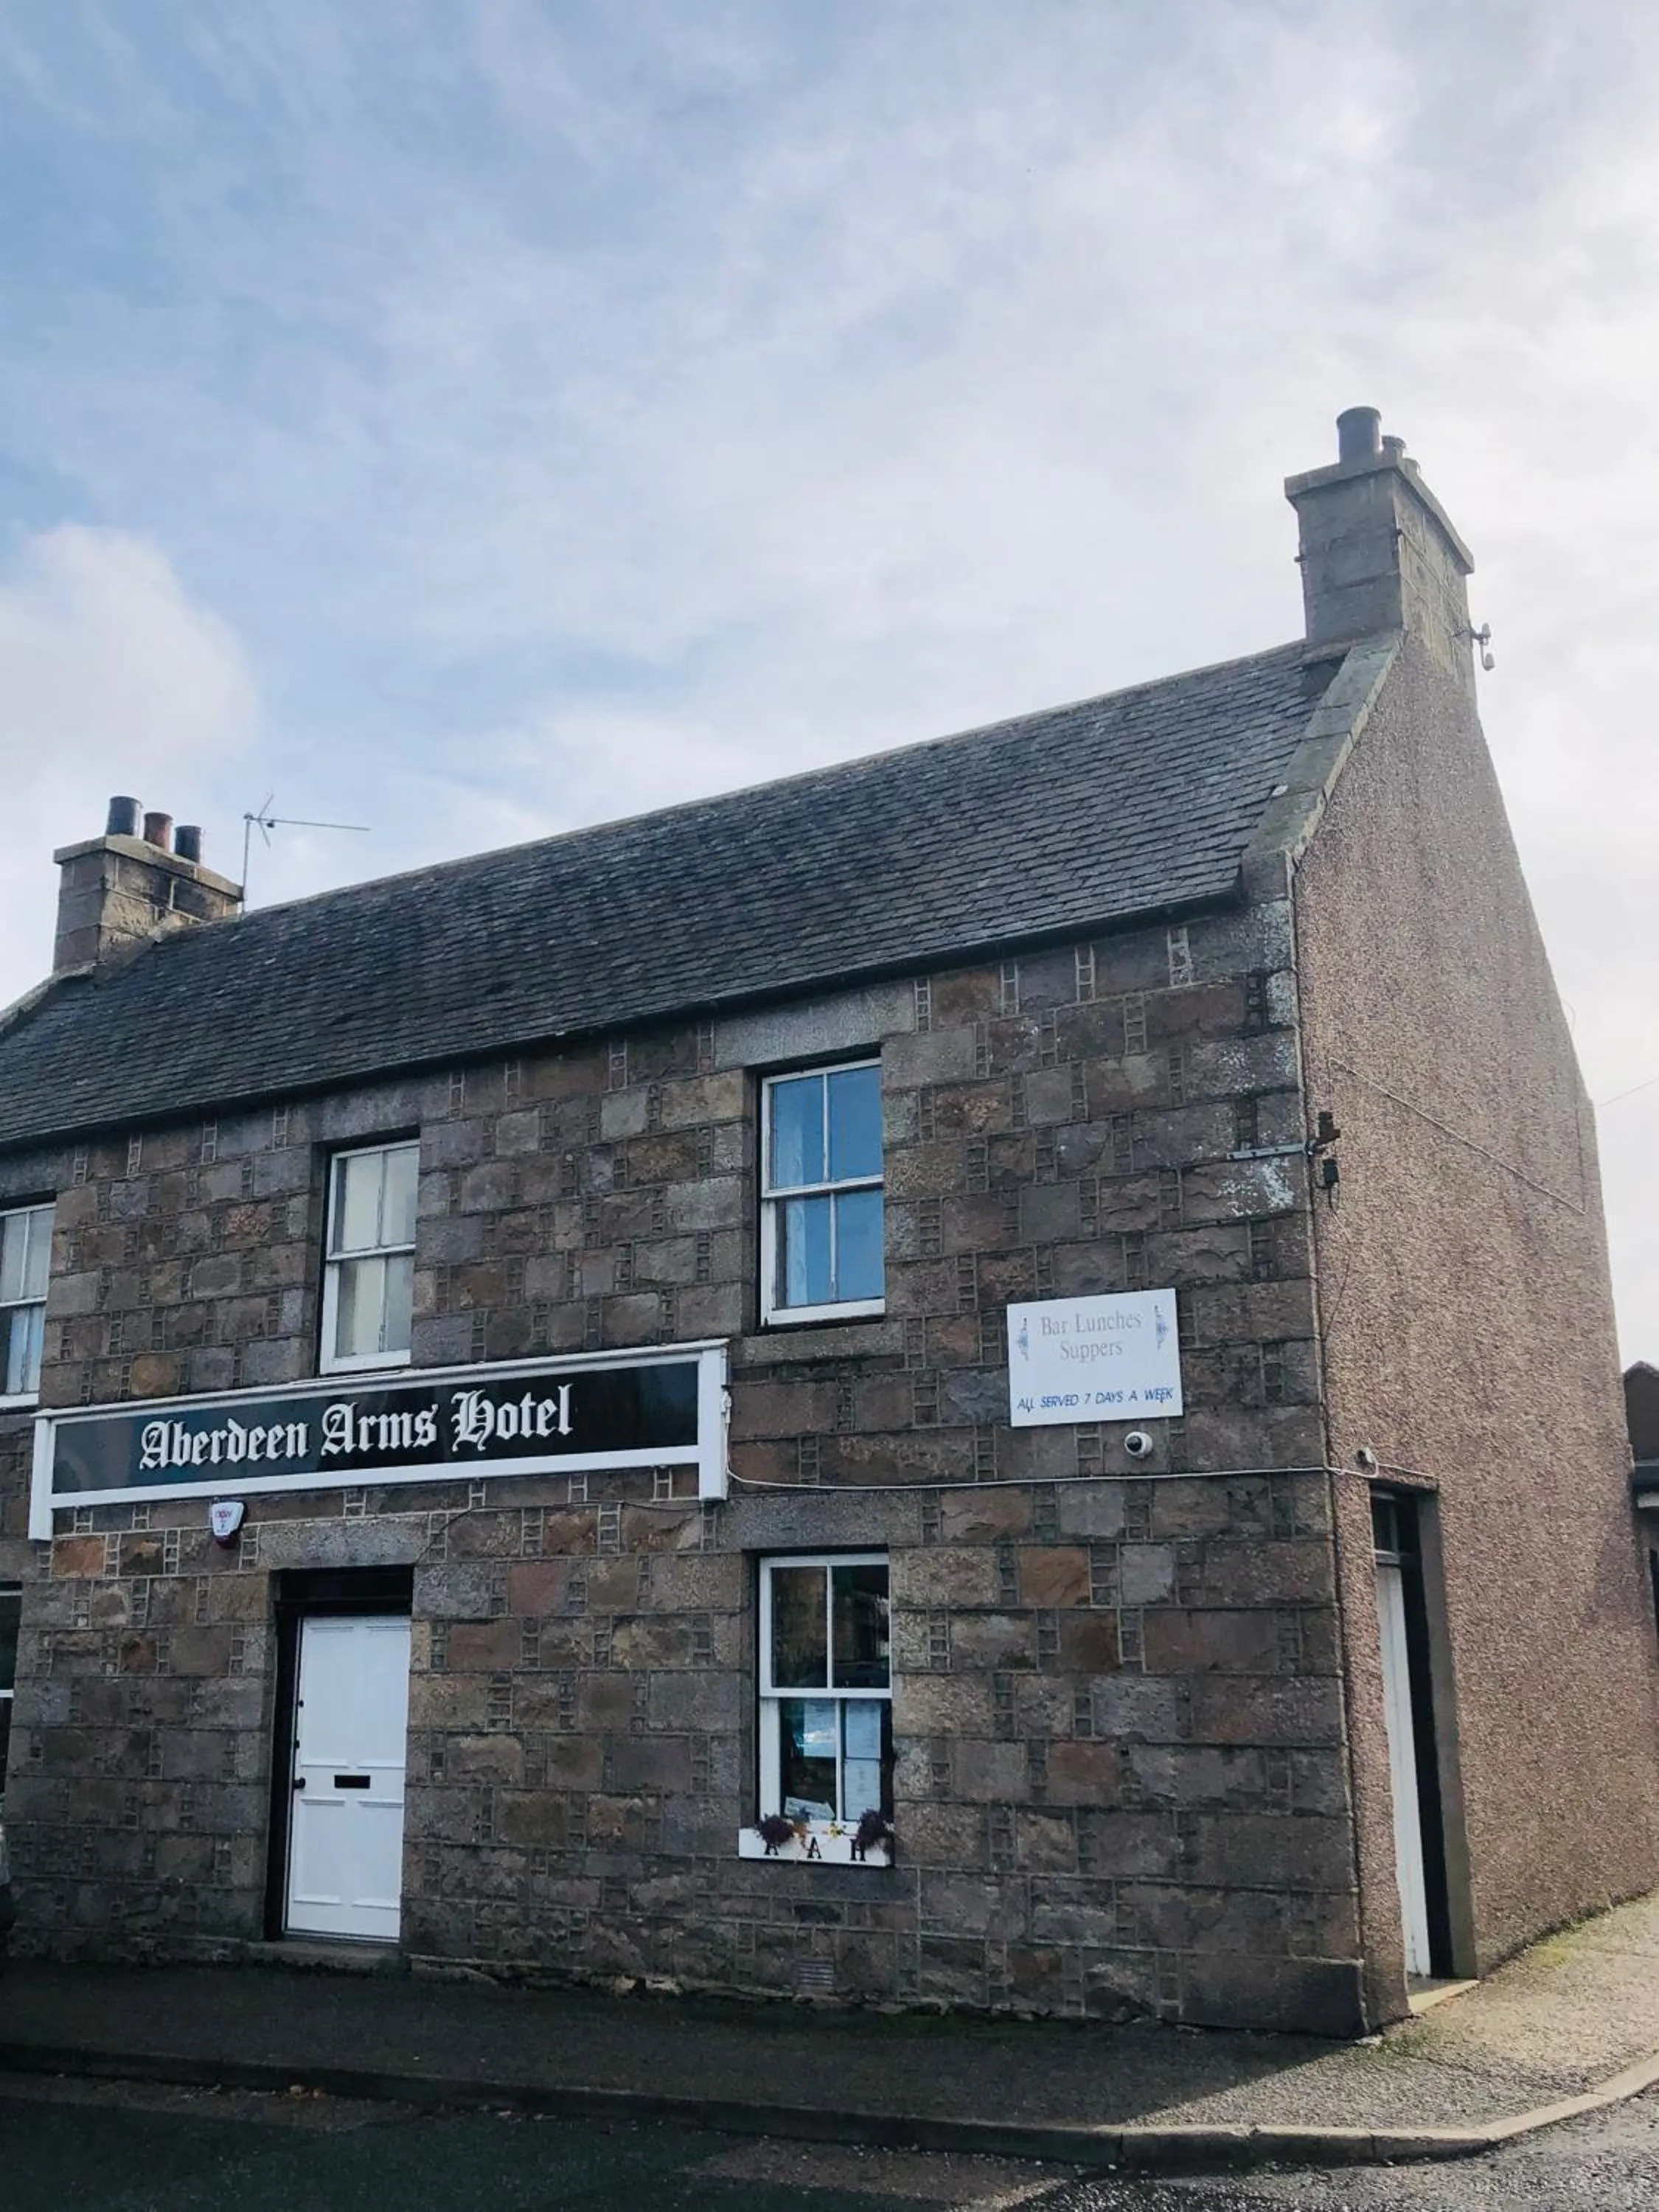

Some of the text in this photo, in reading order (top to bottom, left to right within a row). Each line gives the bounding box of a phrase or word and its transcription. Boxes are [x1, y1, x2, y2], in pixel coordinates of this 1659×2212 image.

[1040, 1309, 1143, 1336] Bar Lunches
[1060, 1340, 1124, 1363] Suppers
[1016, 1386, 1175, 1411] ALL SERVED 7 DAYS A WEEK
[139, 1382, 574, 1471] Aberdeen Arms Hotel
